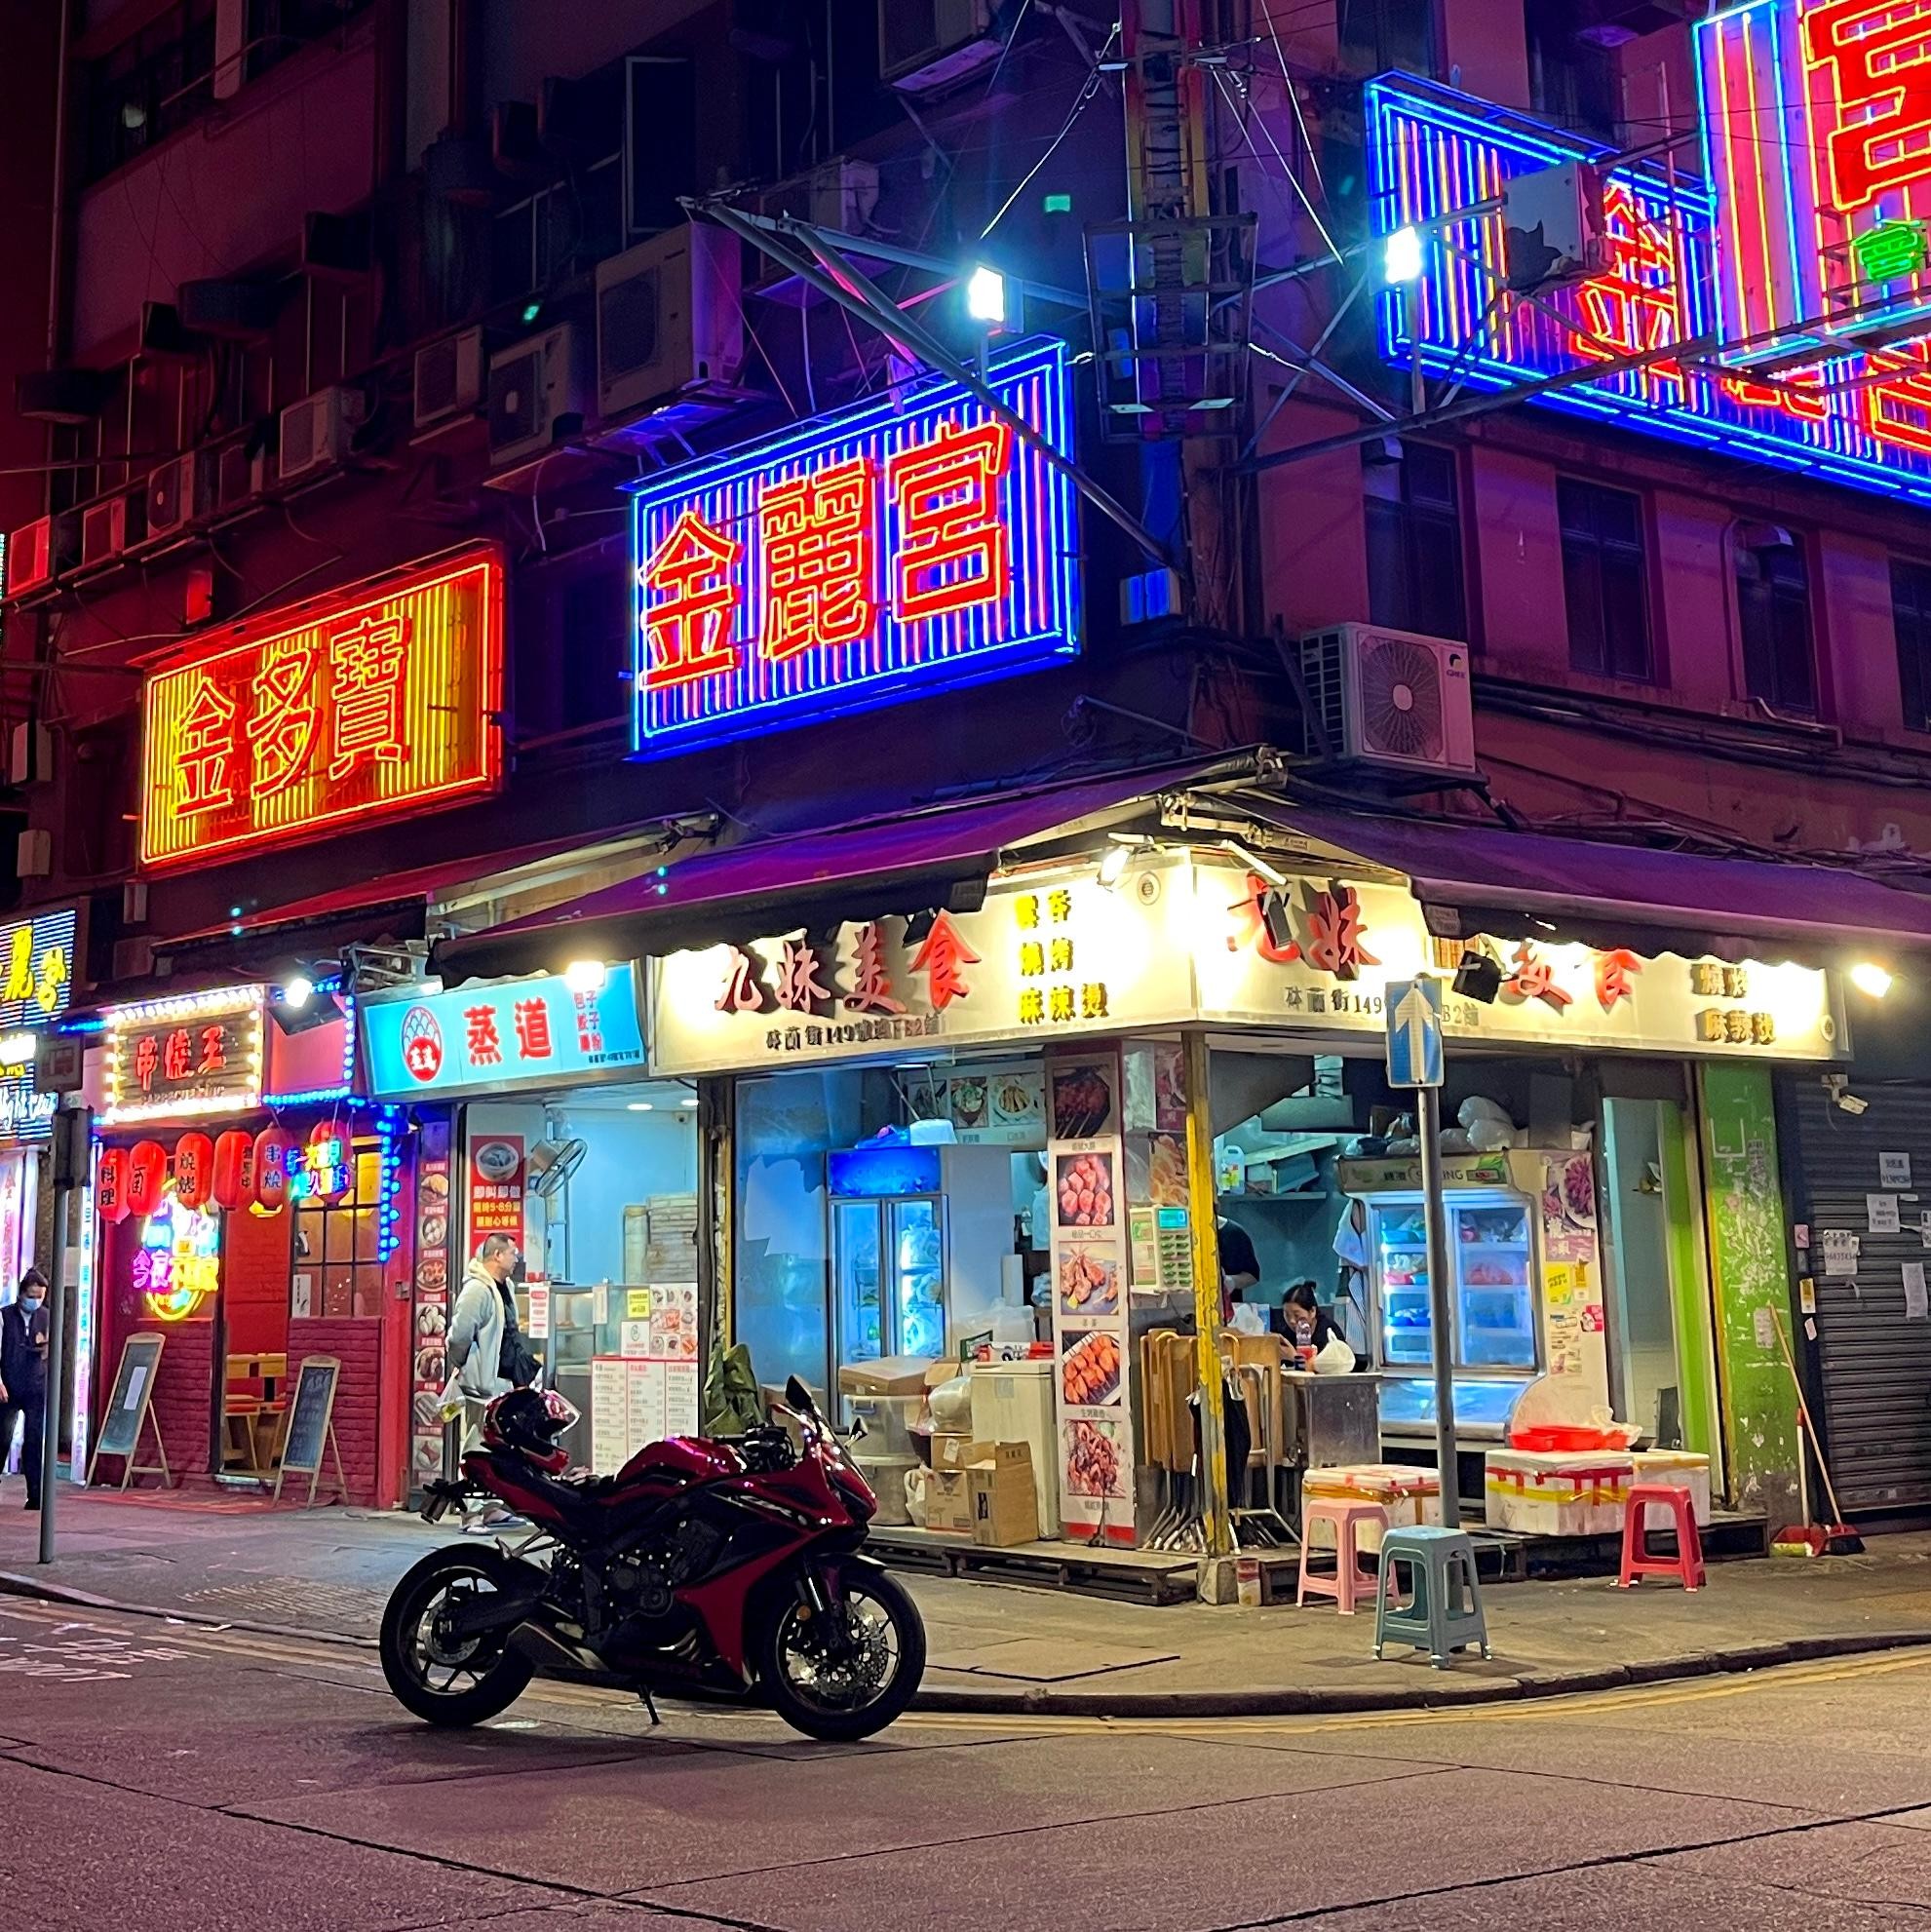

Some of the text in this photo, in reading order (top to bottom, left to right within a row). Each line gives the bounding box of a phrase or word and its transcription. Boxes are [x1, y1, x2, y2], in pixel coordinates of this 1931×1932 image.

[637, 415, 1010, 693] 金麗宮
[172, 616, 405, 819] 金多寶
[463, 997, 553, 1067] 蒸道
